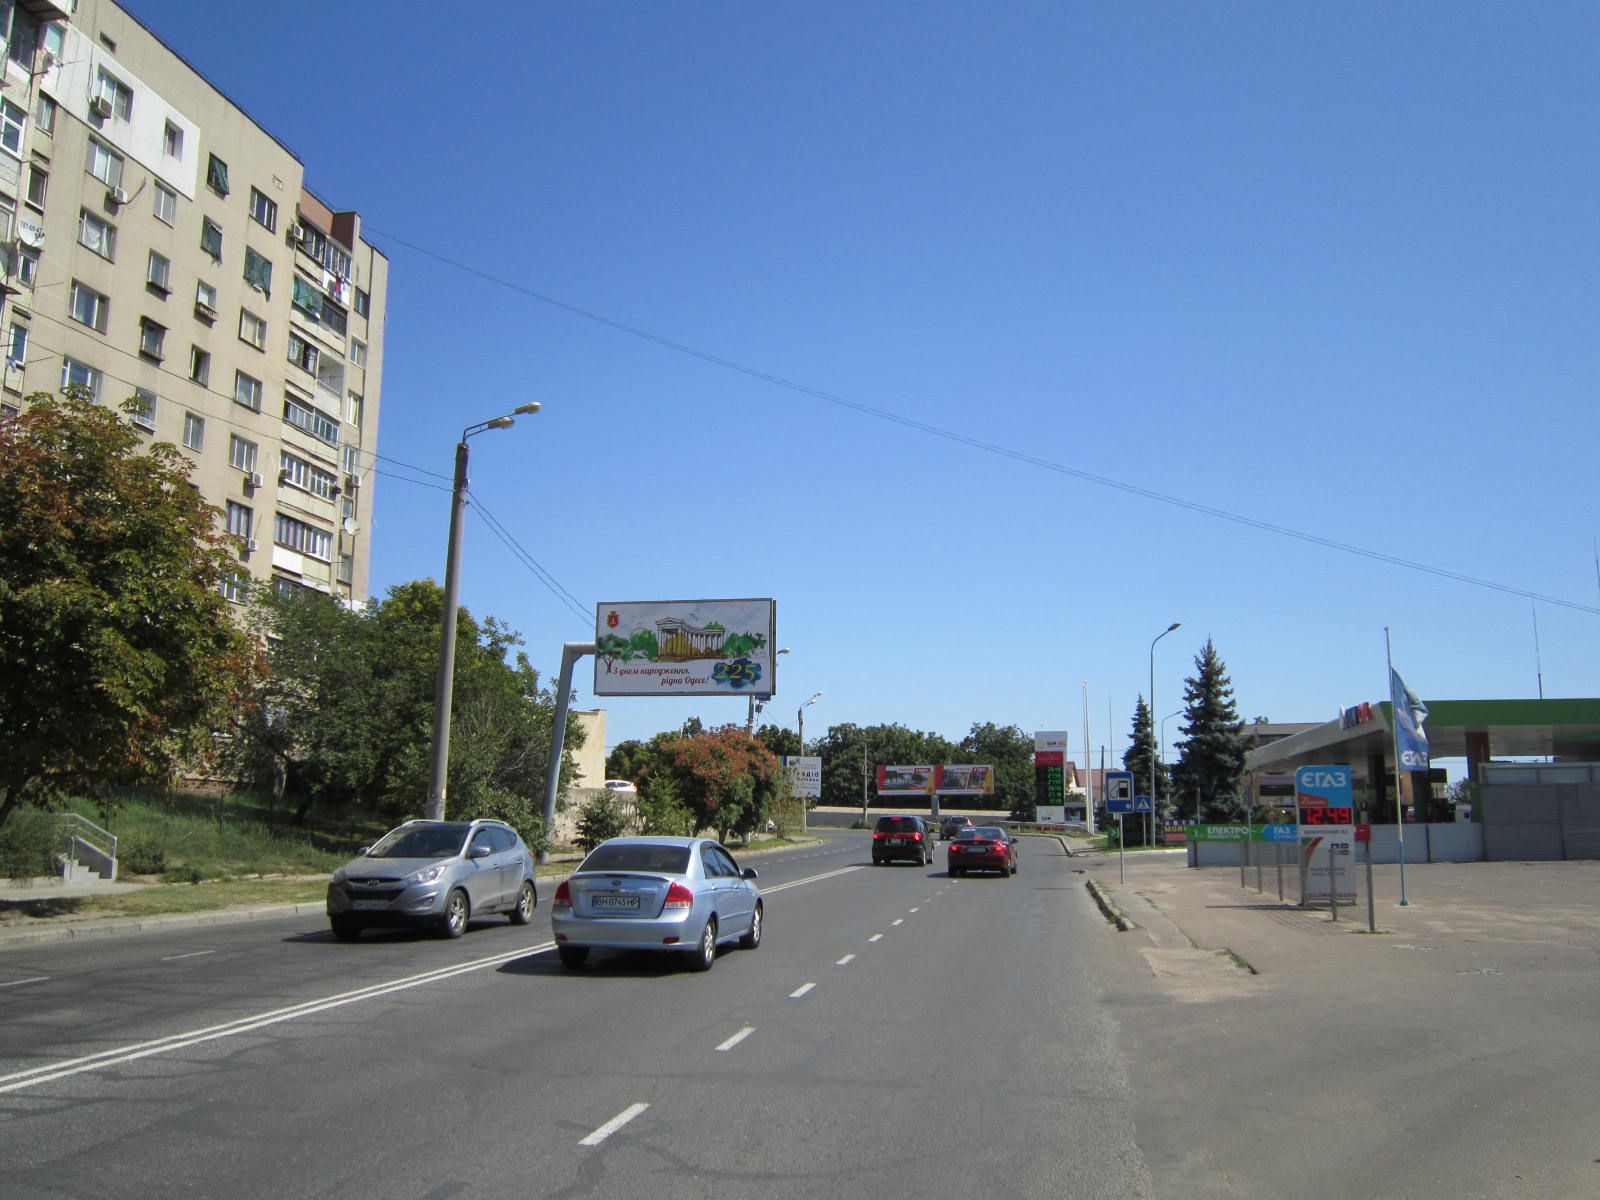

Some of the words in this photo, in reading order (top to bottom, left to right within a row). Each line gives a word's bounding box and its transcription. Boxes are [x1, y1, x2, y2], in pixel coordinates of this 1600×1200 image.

[619, 668, 639, 677] днем
[714, 664, 757, 682] 225
[660, 677, 682, 686] рідна
[1301, 772, 1347, 788] ЄГАЗ
[1306, 807, 1350, 825] 12.49
[1207, 826, 1249, 834] ЕЛЕКТРО
[1273, 826, 1291, 834] ГАЗ
